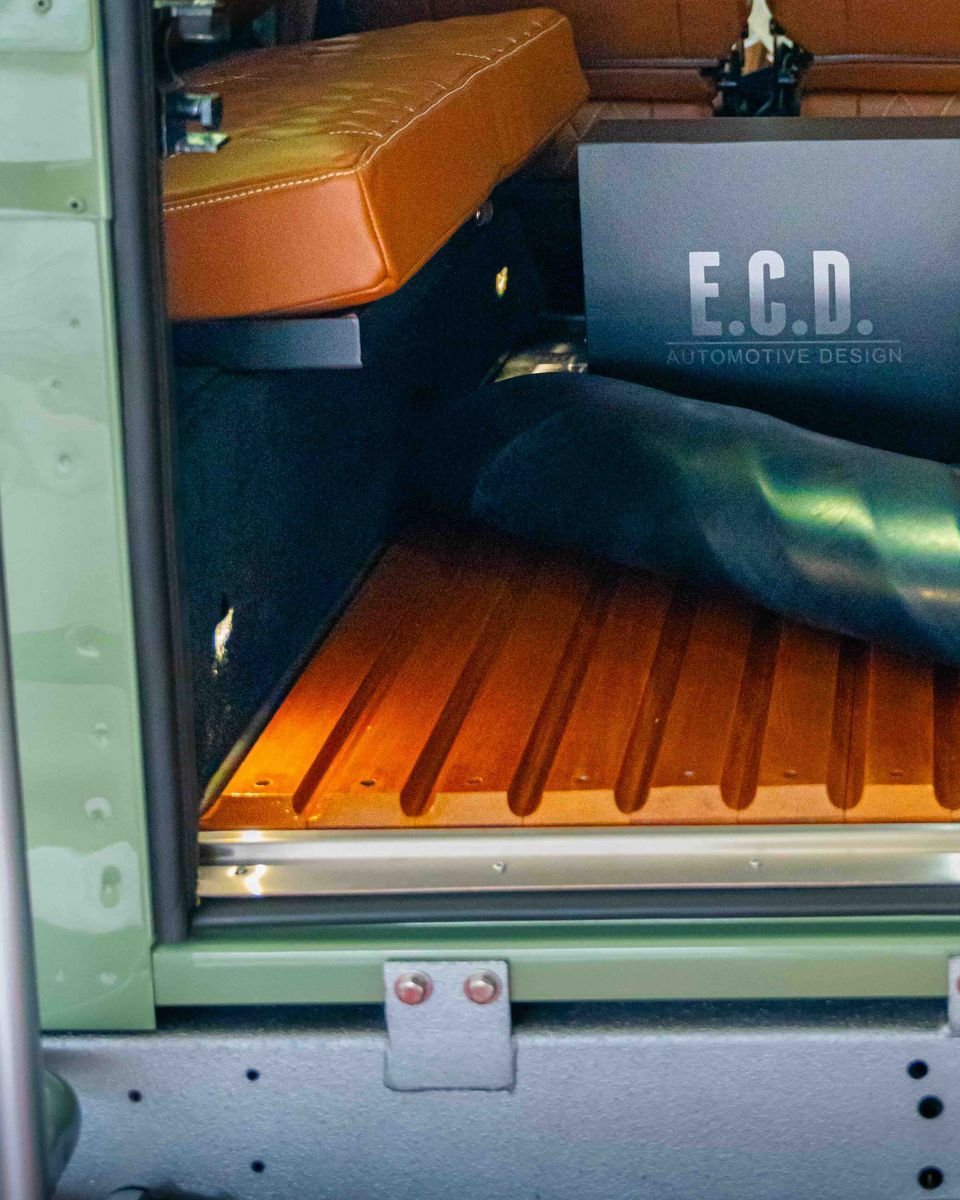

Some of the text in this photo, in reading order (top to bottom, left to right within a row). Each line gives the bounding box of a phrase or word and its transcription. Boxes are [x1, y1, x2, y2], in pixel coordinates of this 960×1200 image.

[689, 250, 873, 336] E.C.D.
[666, 347, 902, 366] AUTOMOTIVE DESIGN
